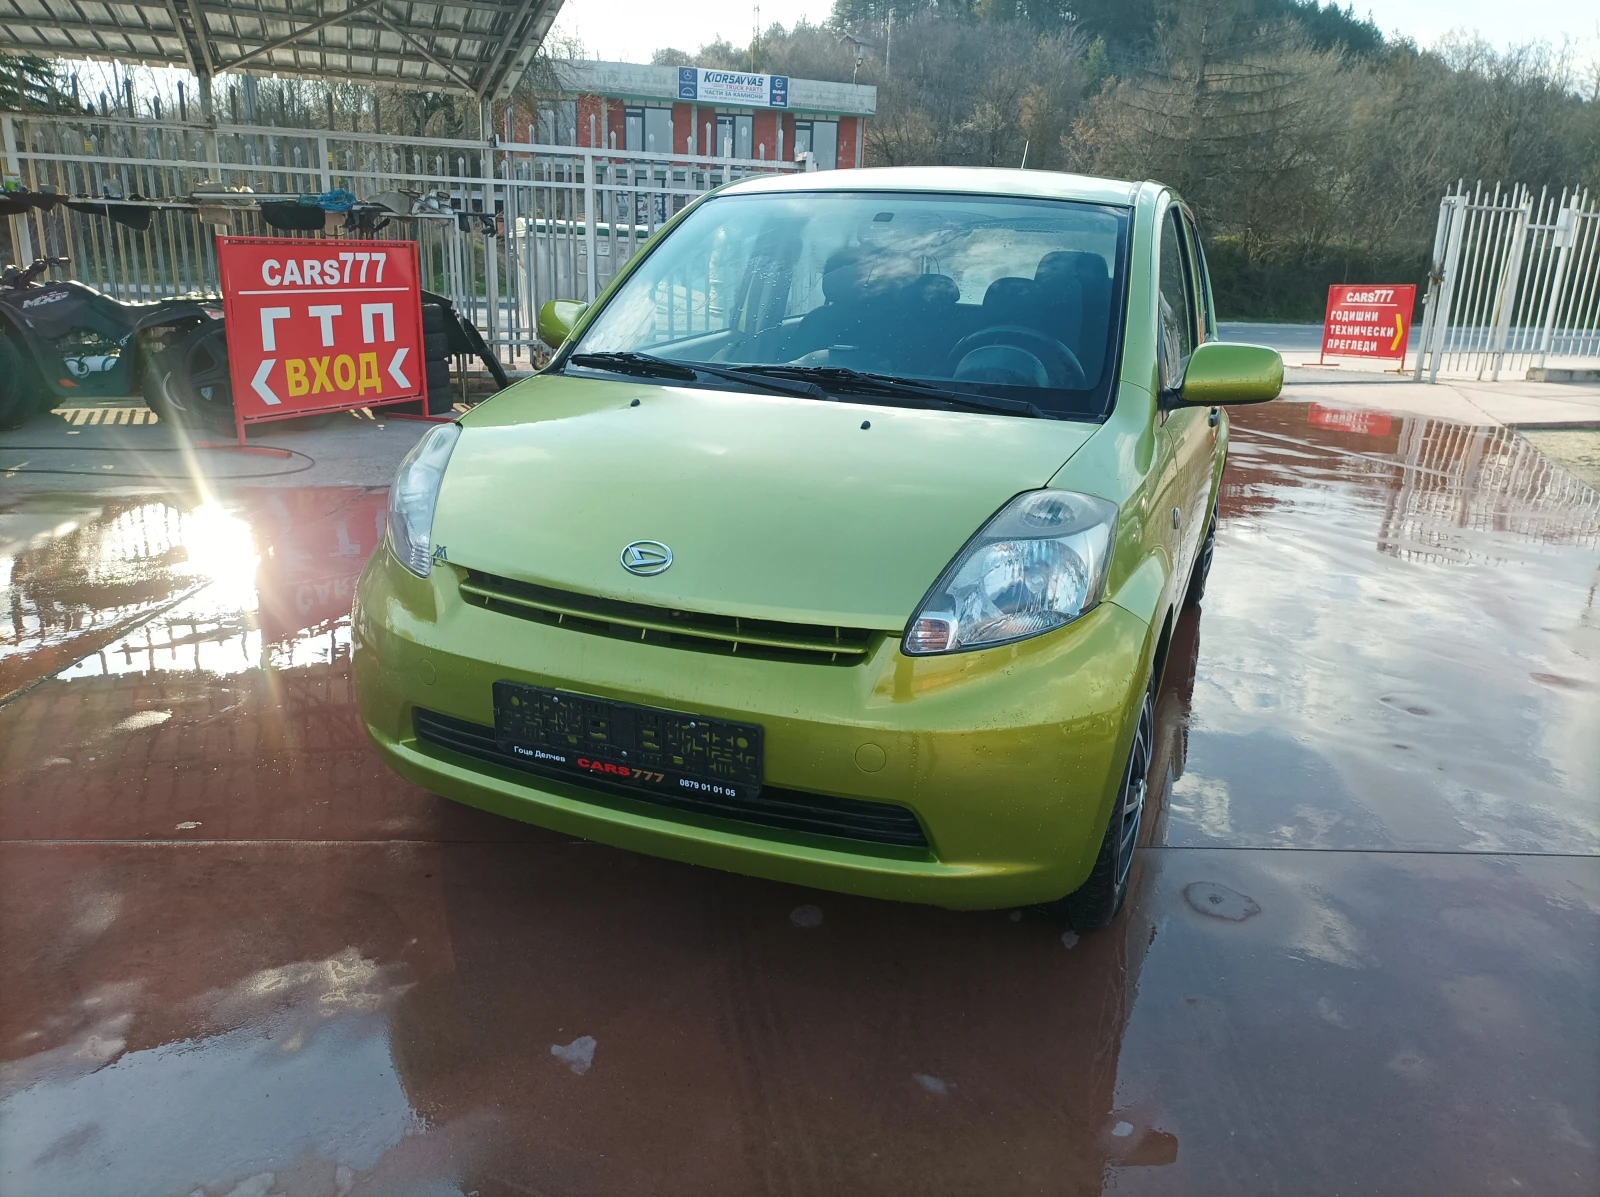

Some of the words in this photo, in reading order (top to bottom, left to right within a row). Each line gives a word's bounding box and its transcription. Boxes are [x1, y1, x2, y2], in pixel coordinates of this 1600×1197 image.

[261, 252, 387, 287] CARS777
[1346, 290, 1395, 303] CARS777
[1330, 310, 1379, 322] ГОДИШНИ
[1330, 324, 1394, 337] ТЕХНИЧЕСКИ
[1327, 338, 1378, 352] ПРЕГЛЕДИ
[285, 351, 382, 397] ВХОД
[514, 745, 533, 758] Гоце
[534, 749, 566, 762] Делчев
[577, 757, 664, 783] CARS777
[679, 778, 699, 790] 0879
[701, 781, 711, 792] 01
[713, 784, 723, 795] 01
[725, 787, 736, 797] 05
